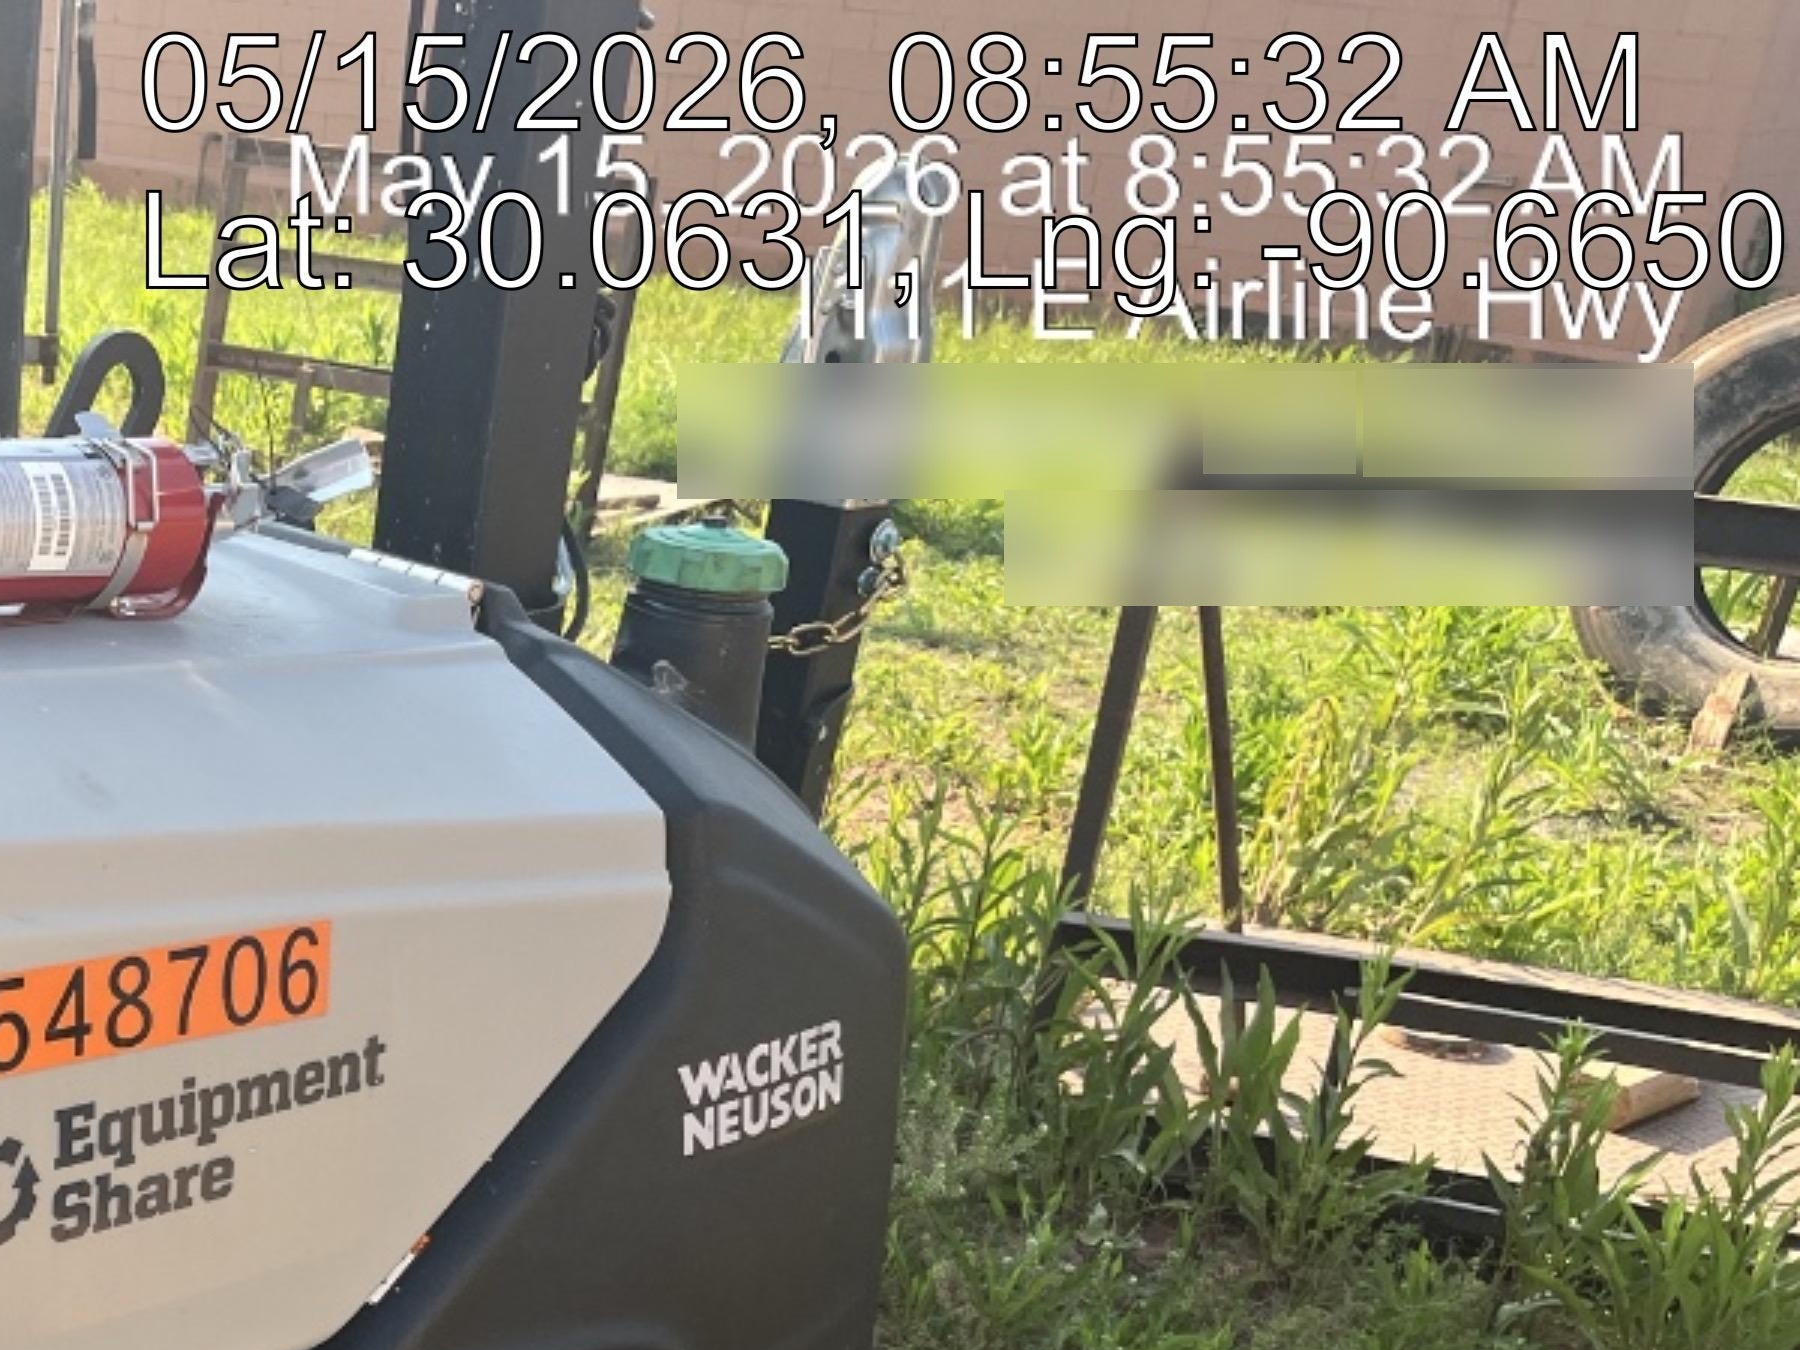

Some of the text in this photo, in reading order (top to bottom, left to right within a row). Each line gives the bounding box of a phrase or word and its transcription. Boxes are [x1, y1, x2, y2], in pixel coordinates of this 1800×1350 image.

[54, 1034, 387, 1168] Equipment
[677, 1019, 844, 1106] WACKER
[683, 1063, 844, 1156] NEUSON
[50, 1156, 235, 1243] Share
